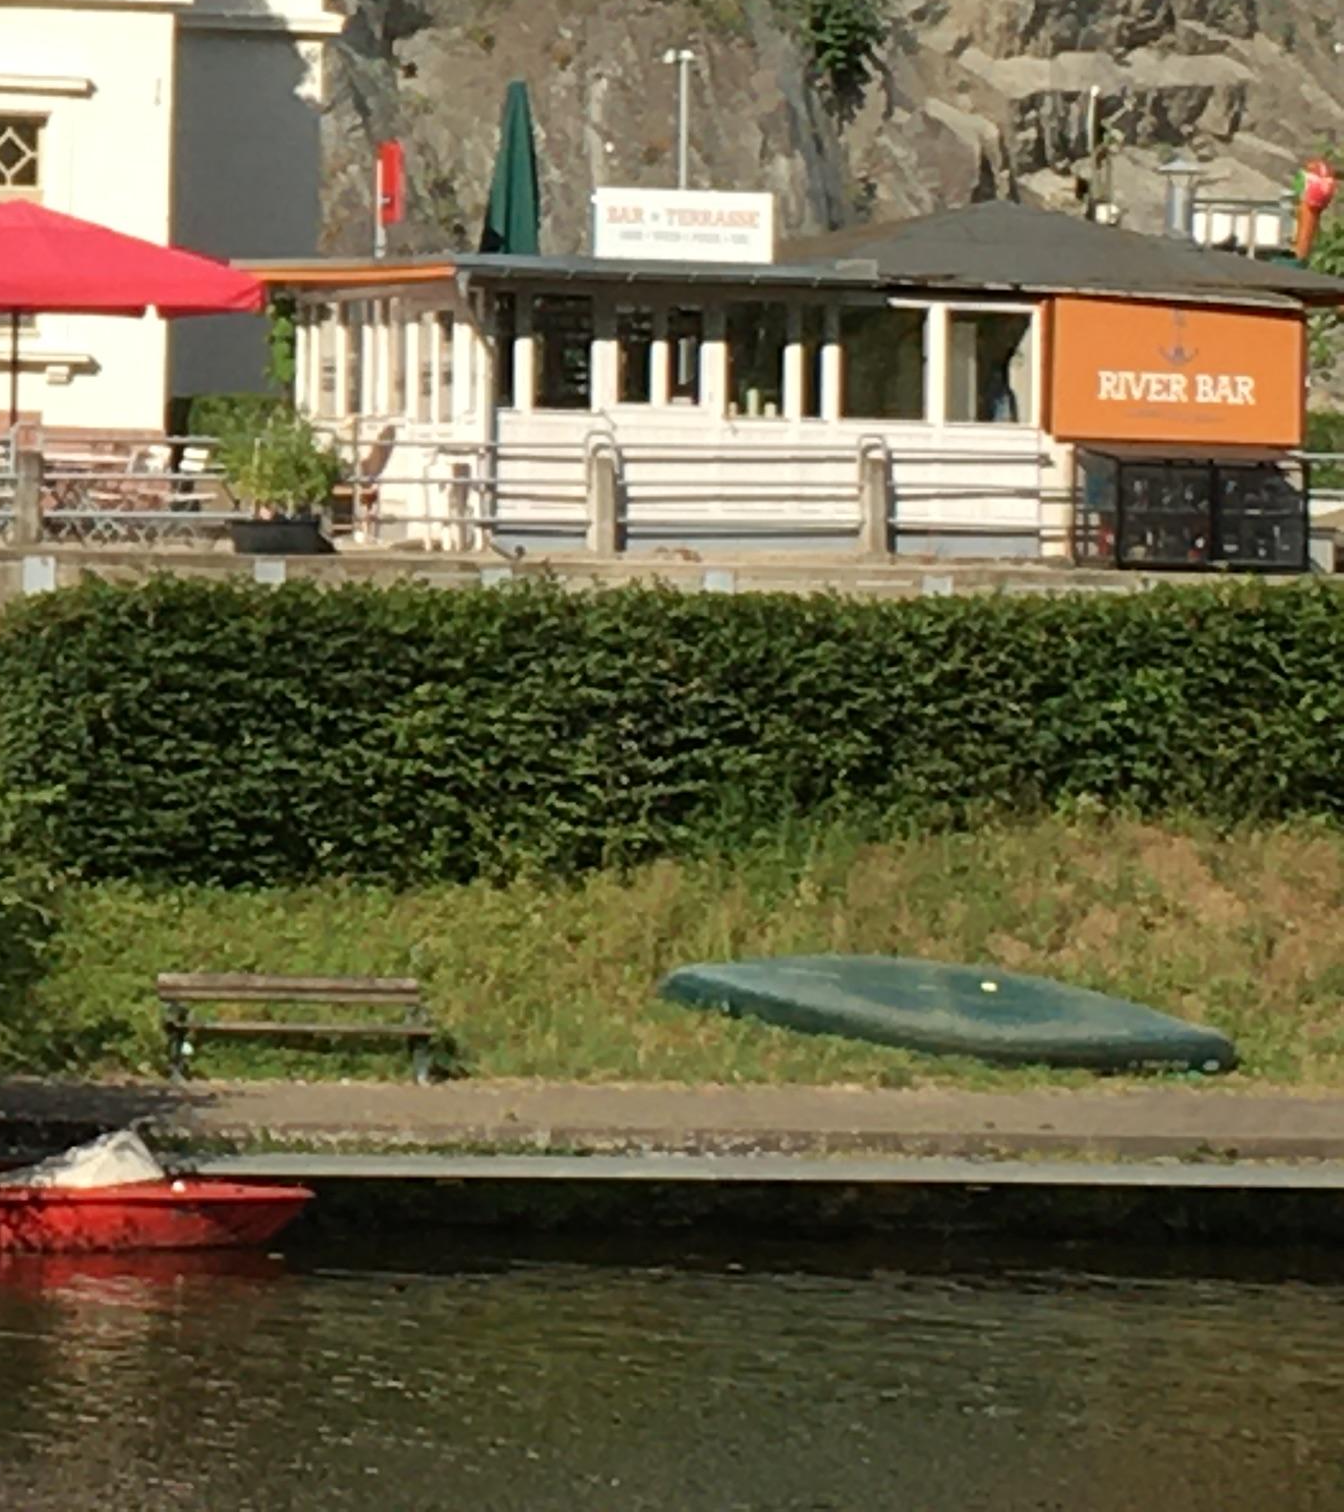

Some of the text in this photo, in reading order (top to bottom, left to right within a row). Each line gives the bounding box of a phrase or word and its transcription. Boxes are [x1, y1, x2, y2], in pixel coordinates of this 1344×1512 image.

[607, 207, 760, 229] BAR TERRASSE
[1098, 371, 1255, 405] RIVER BAR
